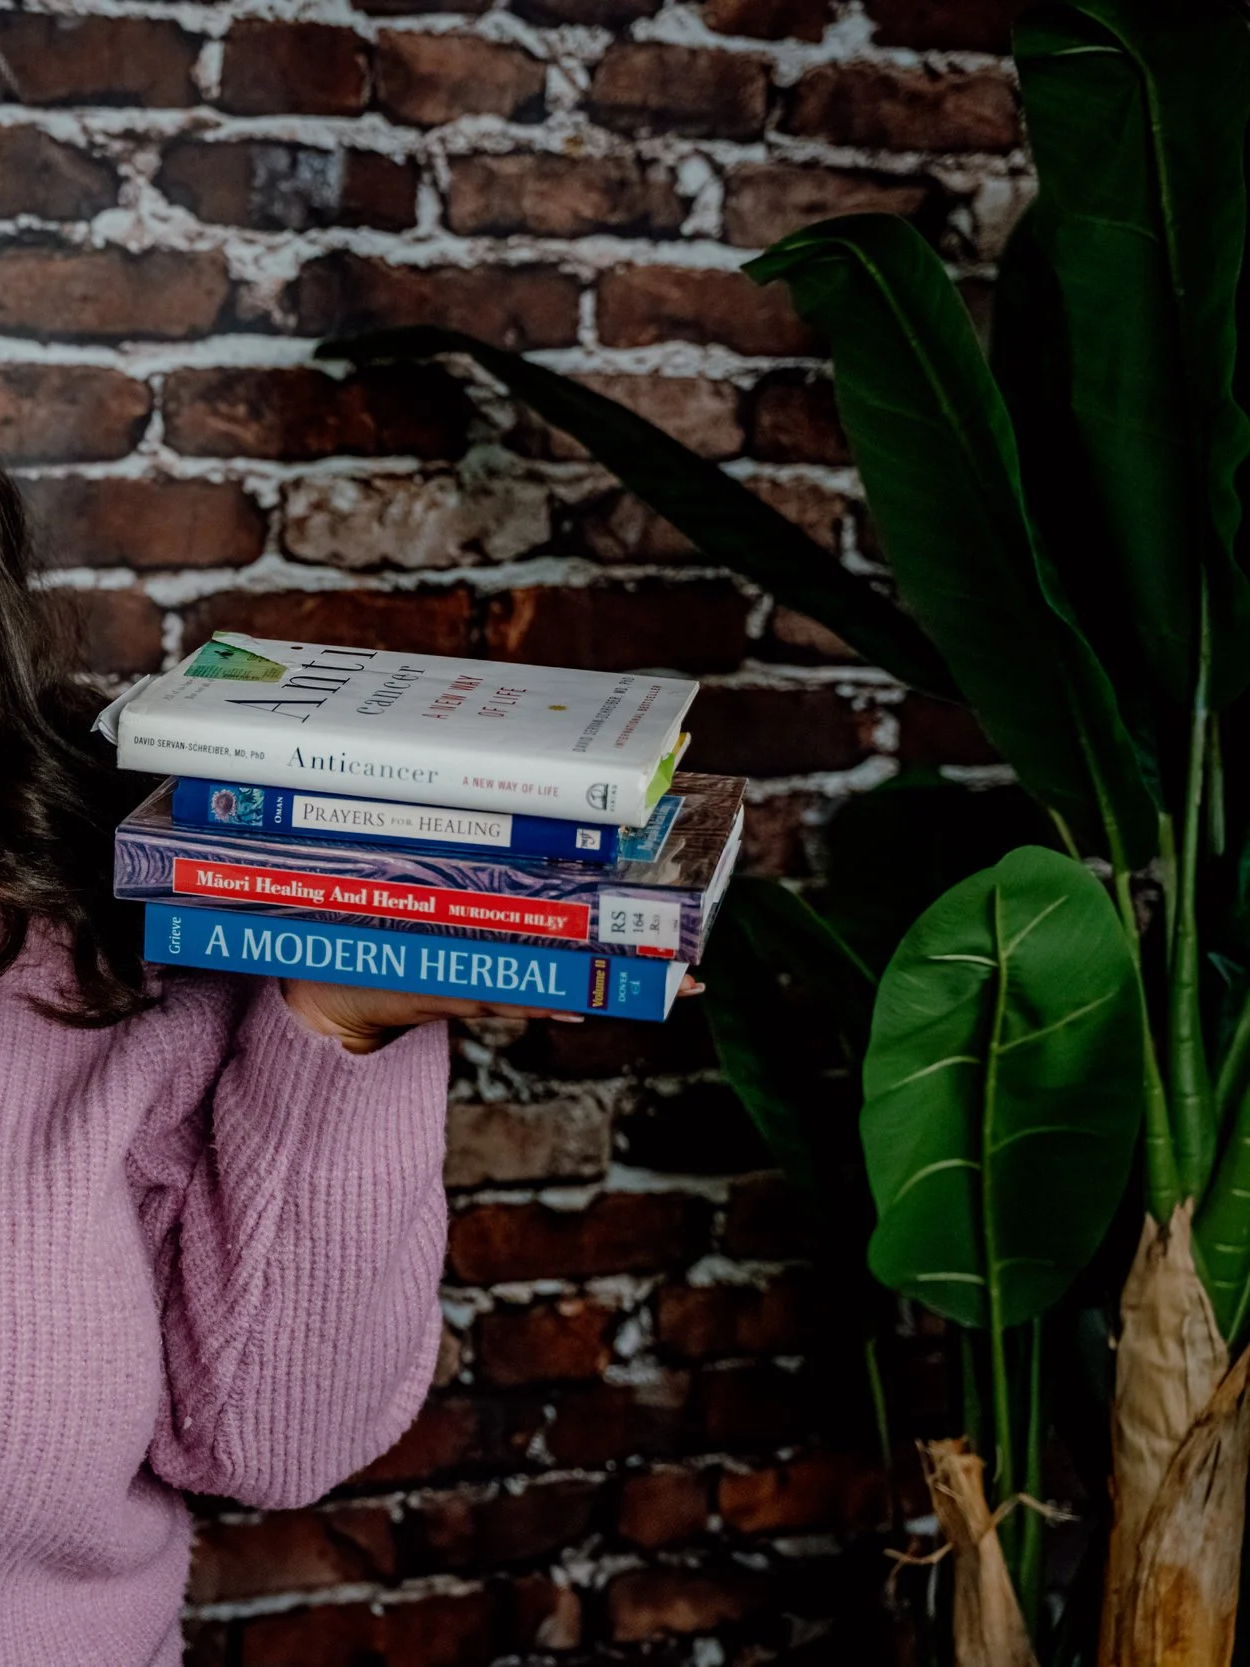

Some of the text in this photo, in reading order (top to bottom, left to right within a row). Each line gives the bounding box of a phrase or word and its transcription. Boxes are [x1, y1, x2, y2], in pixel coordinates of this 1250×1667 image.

[225, 645, 378, 723] Anti
[356, 665, 426, 715] cancer
[447, 674, 484, 692] WAY
[429, 693, 468, 712] NEW
[477, 686, 527, 718] OF LIFE
[133, 735, 265, 760] DAVID SERVAN-SCHREIBER, MD, PhD
[286, 746, 439, 784] Anticancer
[462, 776, 560, 798] A NEW WAY OF LIFE
[274, 796, 283, 824] OMAN
[303, 802, 385, 827] PRAYERS
[419, 816, 502, 839] HEALING
[196, 869, 436, 914] Māori Healing And Herbal
[448, 903, 568, 931] MURDOCH RILEY
[611, 910, 626, 934] RS
[633, 912, 644, 933] 164
[168, 916, 182, 955] Grieve
[205, 924, 567, 997] A MODERN HERBAL
[592, 969, 606, 1008] Volume
[618, 971, 628, 1002] DOVER
